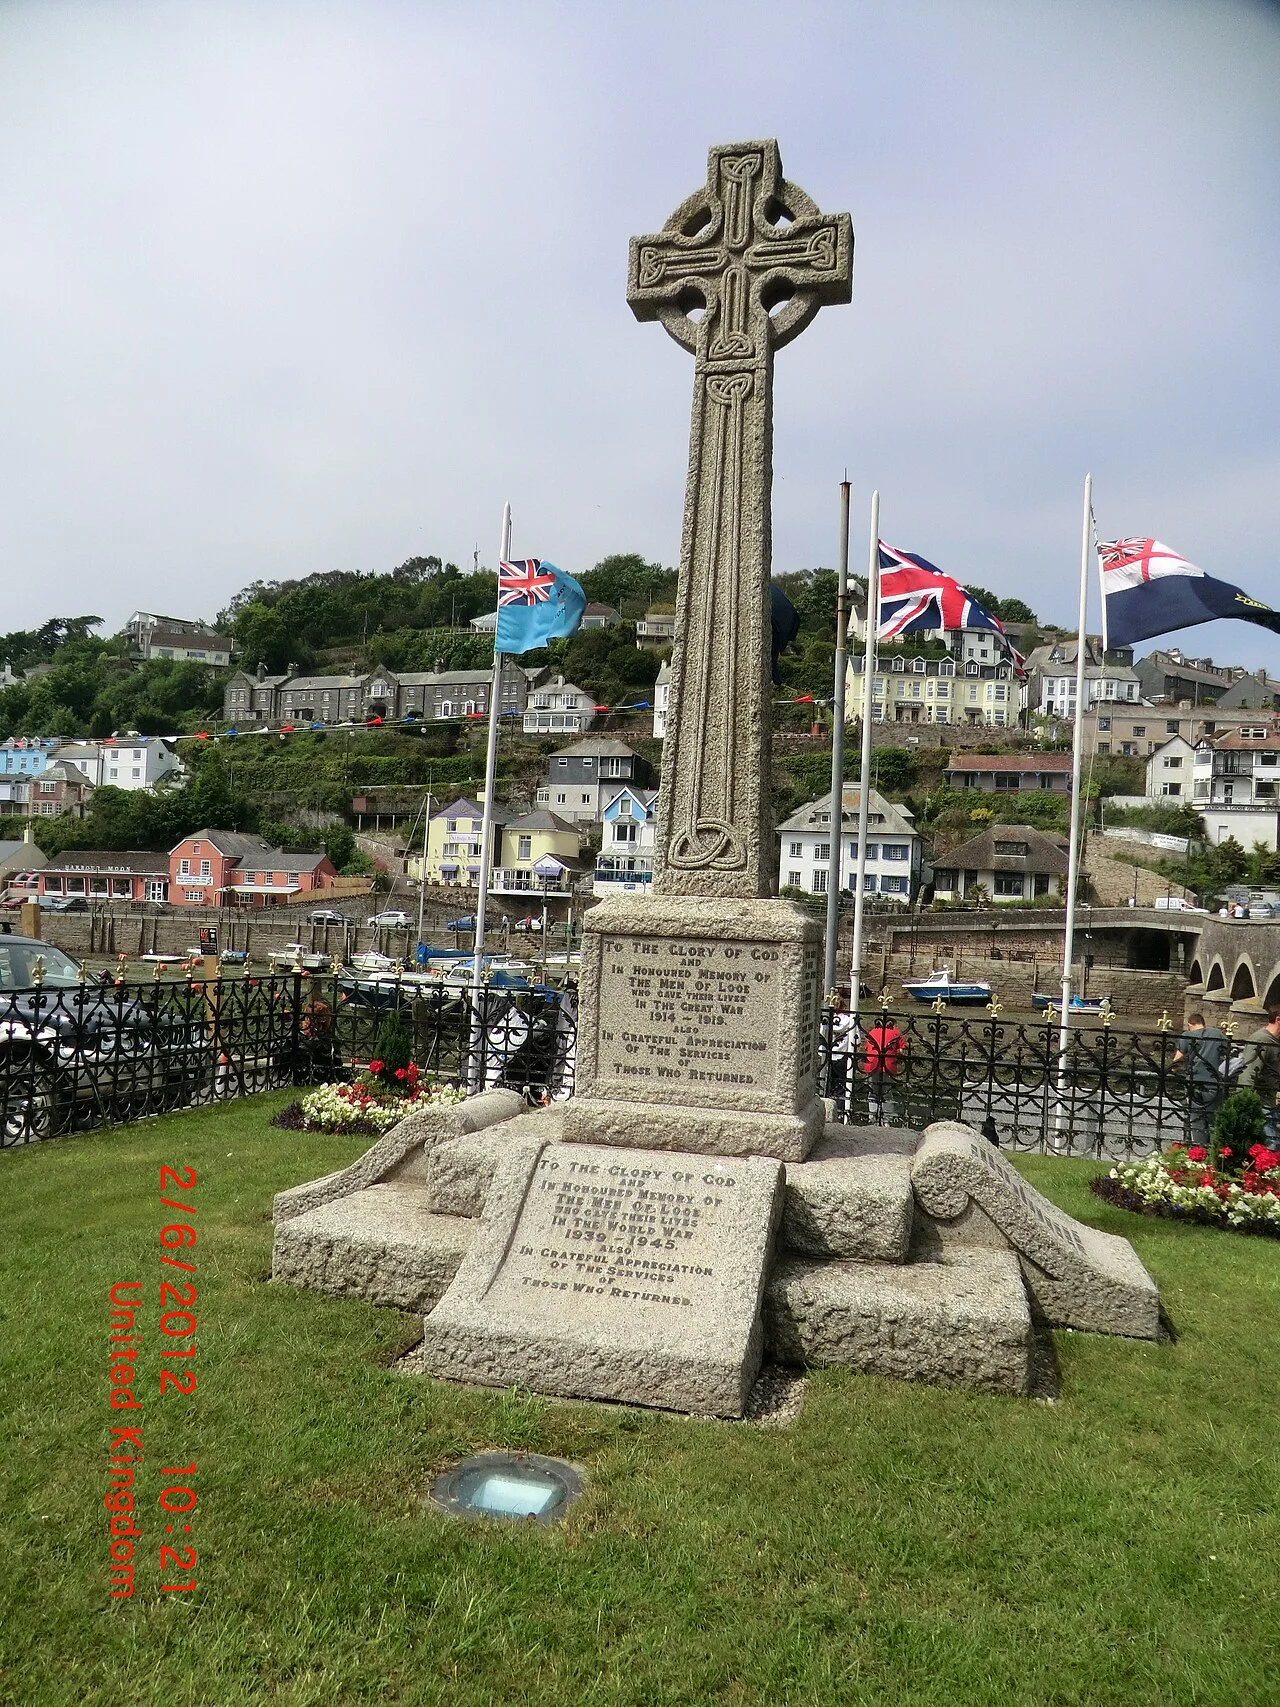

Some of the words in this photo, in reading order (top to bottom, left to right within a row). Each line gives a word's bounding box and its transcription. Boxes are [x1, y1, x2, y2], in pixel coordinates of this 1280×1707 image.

[605, 941, 623, 952] TO
[632, 942, 659, 954] THE
[669, 944, 715, 957] GLORY
[725, 948, 742, 959] OF
[751, 949, 779, 961] GOD
[612, 965, 624, 974] IN
[633, 966, 691, 978] HONOURED
[698, 969, 747, 982] MEMORY
[755, 972, 770, 983] OF
[628, 977, 651, 988] THE
[660, 979, 685, 990] MEN
[695, 981, 711, 991] OF
[719, 982, 750, 994] LOOE
[631, 989, 651, 997] WHO
[657, 991, 682, 999] GAVE
[686, 993, 714, 1001] THEIR
[718, 994, 746, 1003] LIVES
[635, 999, 647, 1009] IN
[654, 1000, 675, 1011] THE
[680, 1002, 714, 1013] GREAT
[721, 1005, 744, 1015] WAR
[650, 1012, 676, 1023] 1914
[698, 1014, 728, 1026] 1919.
[673, 1026, 699, 1034] ALSO
[602, 1030, 614, 1041] IN
[621, 1032, 678, 1045] GRATEFUL
[686, 1036, 767, 1051] APPRECIATION
[625, 1044, 640, 1054] OF
[648, 1045, 671, 1056] THE
[679, 1048, 731, 1061] SERVICES
[613, 1063, 651, 1076] THOSE
[657, 1067, 682, 1078] WHO
[688, 1069, 758, 1085] RETURNED.
[540, 1160, 559, 1170] TO
[570, 1162, 600, 1174] THE
[608, 1166, 662, 1180] GLORY
[672, 1171, 694, 1182] OF
[703, 1174, 736, 1187] GOD
[619, 1179, 645, 1188] AND
[540, 1180, 556, 1190] IN
[562, 1182, 633, 1198] HONOURED
[638, 1189, 695, 1204] MEMORY
[704, 1196, 723, 1207] OF
[557, 1193, 584, 1206] THE
[591, 1197, 622, 1209] MEN
[660, 1203, 701, 1218] LOOE
[554, 1206, 580, 1215] WHO
[584, 1208, 618, 1219] GAVE
[621, 1213, 657, 1223] THEIR
[660, 1216, 699, 1228] LIVES
[552, 1216, 567, 1226] IN
[573, 1218, 600, 1230] THE
[607, 1221, 656, 1235] WORLD
[662, 1226, 694, 1240] WAR
[565, 1228, 607, 1242] 1939
[629, 1236, 679, 1251] 1945.
[599, 1245, 632, 1255] ALSO
[519, 1246, 534, 1256] IN
[540, 1248, 609, 1264] GRATEFUL
[614, 1256, 714, 1276] APPRECIATION
[550, 1261, 569, 1270] OF
[576, 1263, 604, 1274] THE
[606, 1266, 675, 1283] SERVICES
[598, 1277, 616, 1285] OF
[521, 1277, 569, 1291] THOSE
[573, 1283, 605, 1295] WHO
[610, 1287, 695, 1308] RETURNED.
